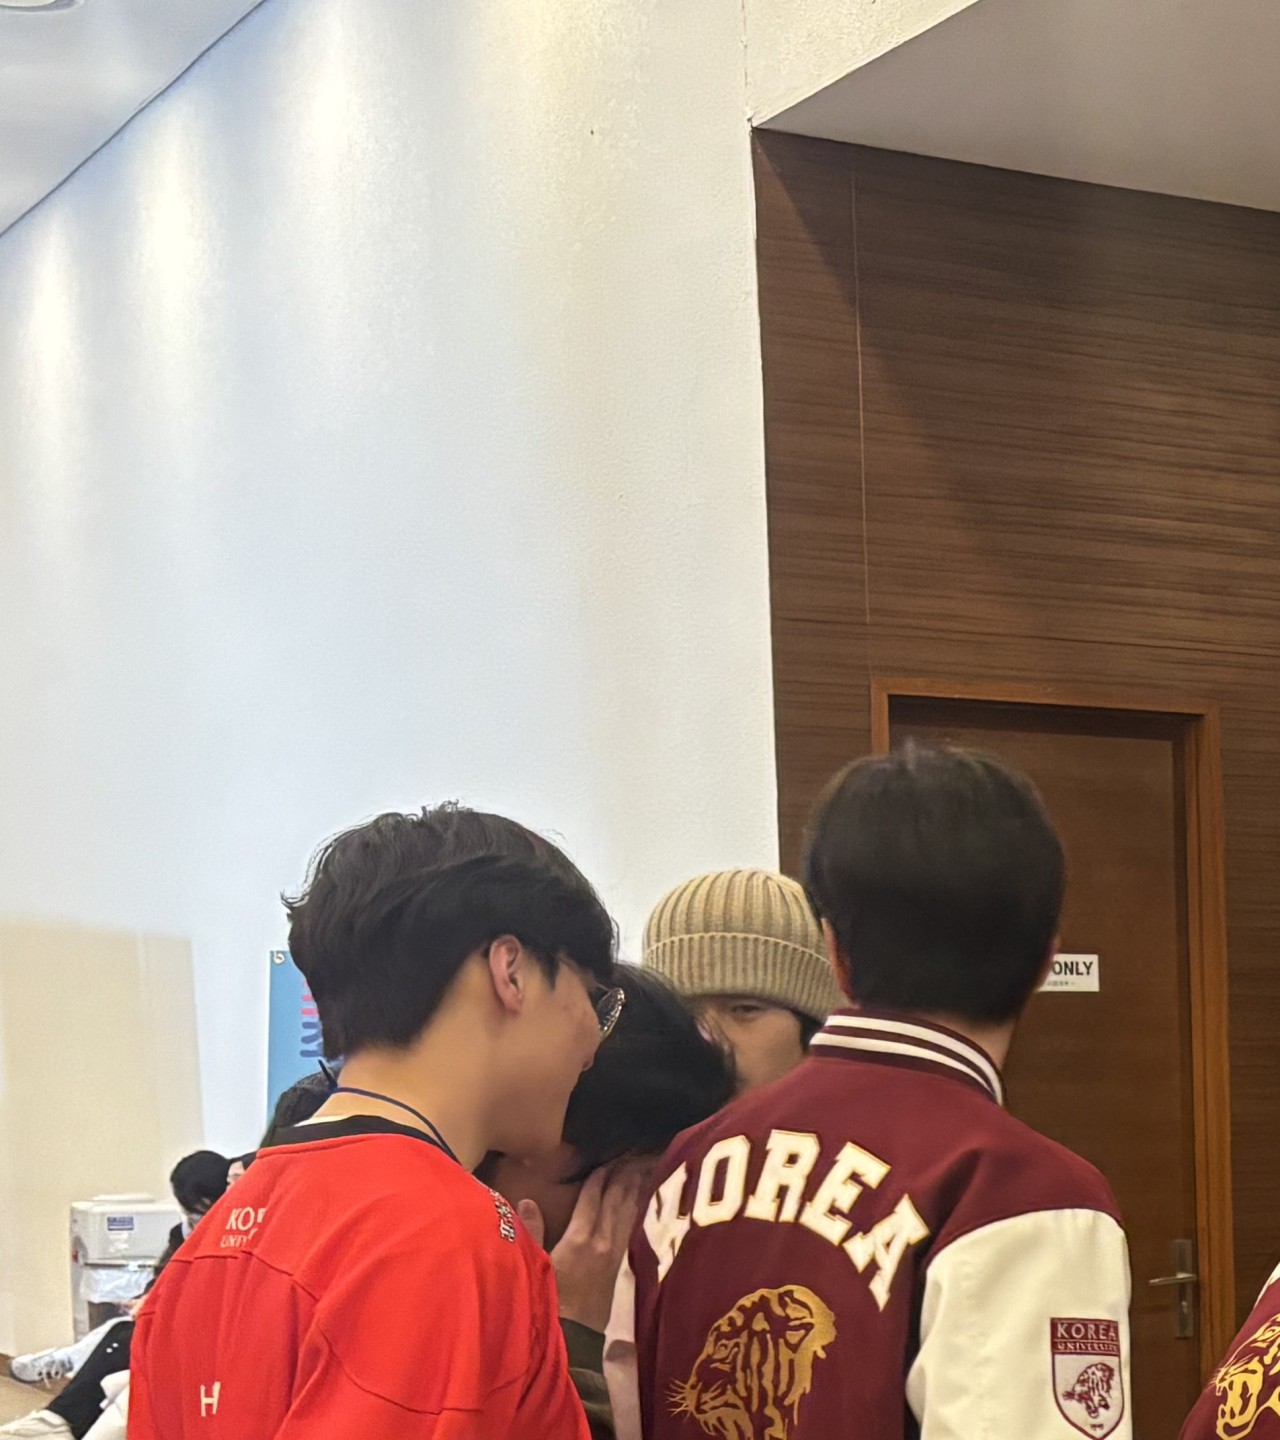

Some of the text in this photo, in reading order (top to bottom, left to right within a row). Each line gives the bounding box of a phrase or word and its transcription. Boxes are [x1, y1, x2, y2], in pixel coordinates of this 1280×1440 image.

[1052, 961, 1094, 976] ONLY
[643, 1128, 931, 1313] KOREA
[1057, 1323, 1117, 1341] KOREA
